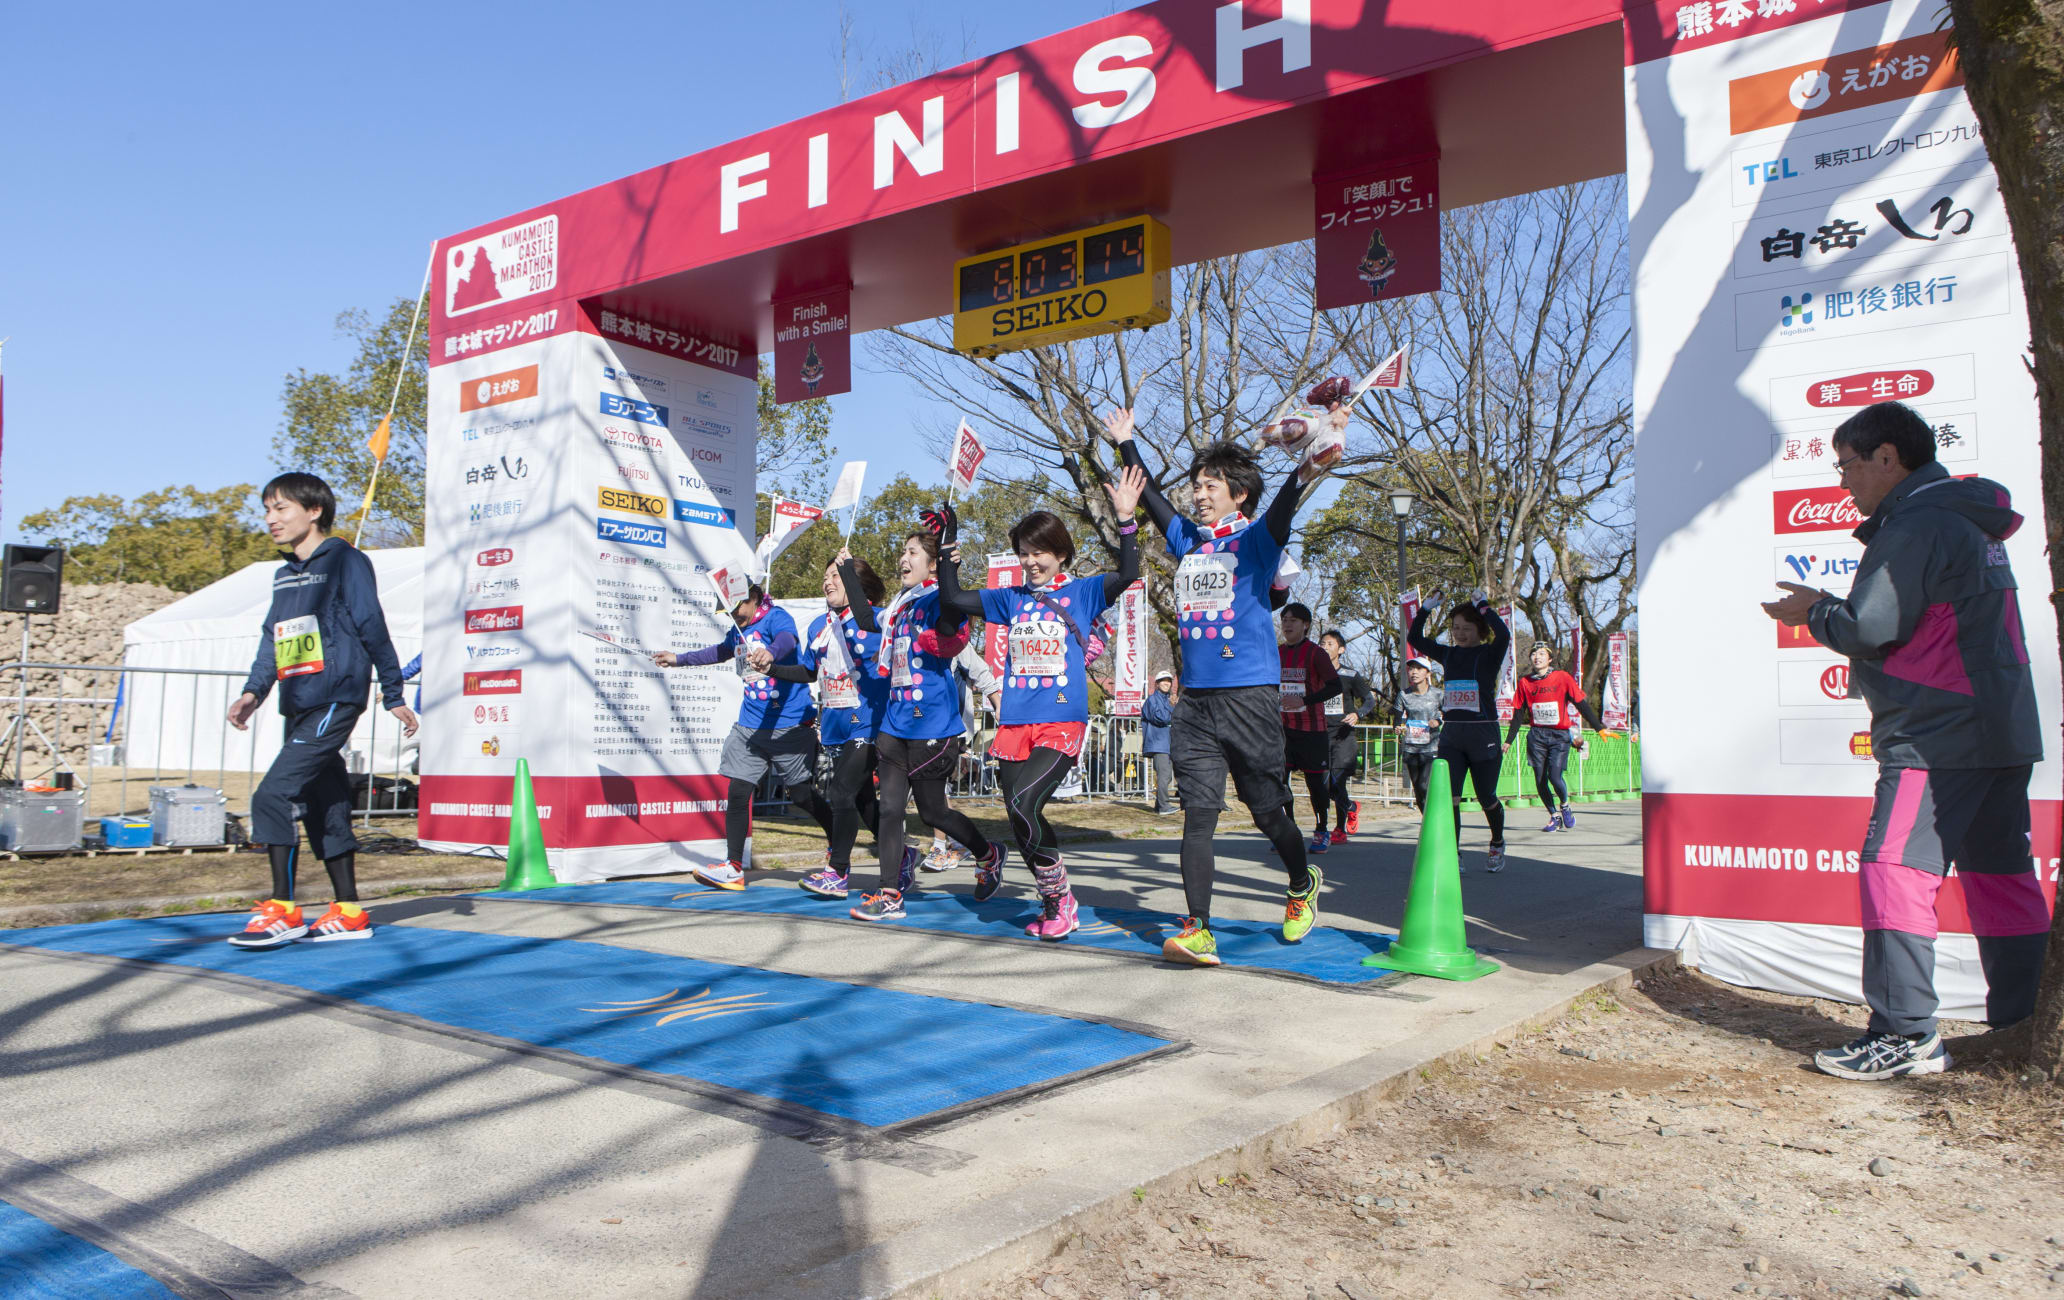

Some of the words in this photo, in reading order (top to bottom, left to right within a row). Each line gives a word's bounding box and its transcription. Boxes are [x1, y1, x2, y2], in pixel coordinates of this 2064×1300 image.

[1676, 0, 1825, 40] 熊本城
[1839, 53, 1930, 95] えがお
[720, 0, 1311, 234] FINISH
[1742, 157, 1799, 187] TEL
[1813, 121, 1985, 171] 東京エレクトロン九州
[1343, 176, 1413, 205] 『笑顔』で
[1321, 193, 1433, 230] フィニッシュ！
[501, 219, 554, 249] KUMAMOTO
[518, 235, 553, 261] CASTLE
[500, 252, 553, 283] MARATHON
[529, 271, 553, 292] 2017
[1824, 274, 1959, 322] 肥後銀行
[793, 302, 827, 322] Finish
[992, 289, 1107, 337] SEIKO
[445, 309, 558, 358] 熊本城マラソン2017
[600, 310, 739, 368] 熊本城マラソン2017
[777, 325, 800, 343] with
[802, 326, 809, 337] a
[812, 314, 848, 335] Smile!
[1779, 326, 1816, 337] HigoBank
[492, 379, 520, 398] えがお
[1819, 373, 1921, 405] 第一生命
[608, 397, 661, 425] シアーズ
[463, 428, 479, 441] TEL
[621, 431, 663, 448] TOYOTA
[691, 447, 722, 464] J:COM
[1782, 436, 1827, 461] 黒糖
[618, 465, 649, 481] FUJITSU
[678, 475, 701, 489] TKU
[602, 490, 664, 515] SEIKO
[600, 522, 665, 545] エアーサロンパス
[1184, 572, 1227, 592] 16423
[496, 609, 519, 629] West
[278, 635, 315, 659] 7710
[1019, 639, 1060, 656] 16422
[824, 677, 853, 692] 16424
[430, 802, 469, 817] KUMAMOTO
[469, 803, 494, 818] CASTLE
[585, 803, 638, 818] KUMAMOTO
[640, 801, 671, 815] CASTLE
[673, 800, 716, 814] MARATHON
[717, 800, 729, 812] 20
[1684, 844, 1808, 872] KUMAMOTO
[1815, 849, 1860, 875] CAS
